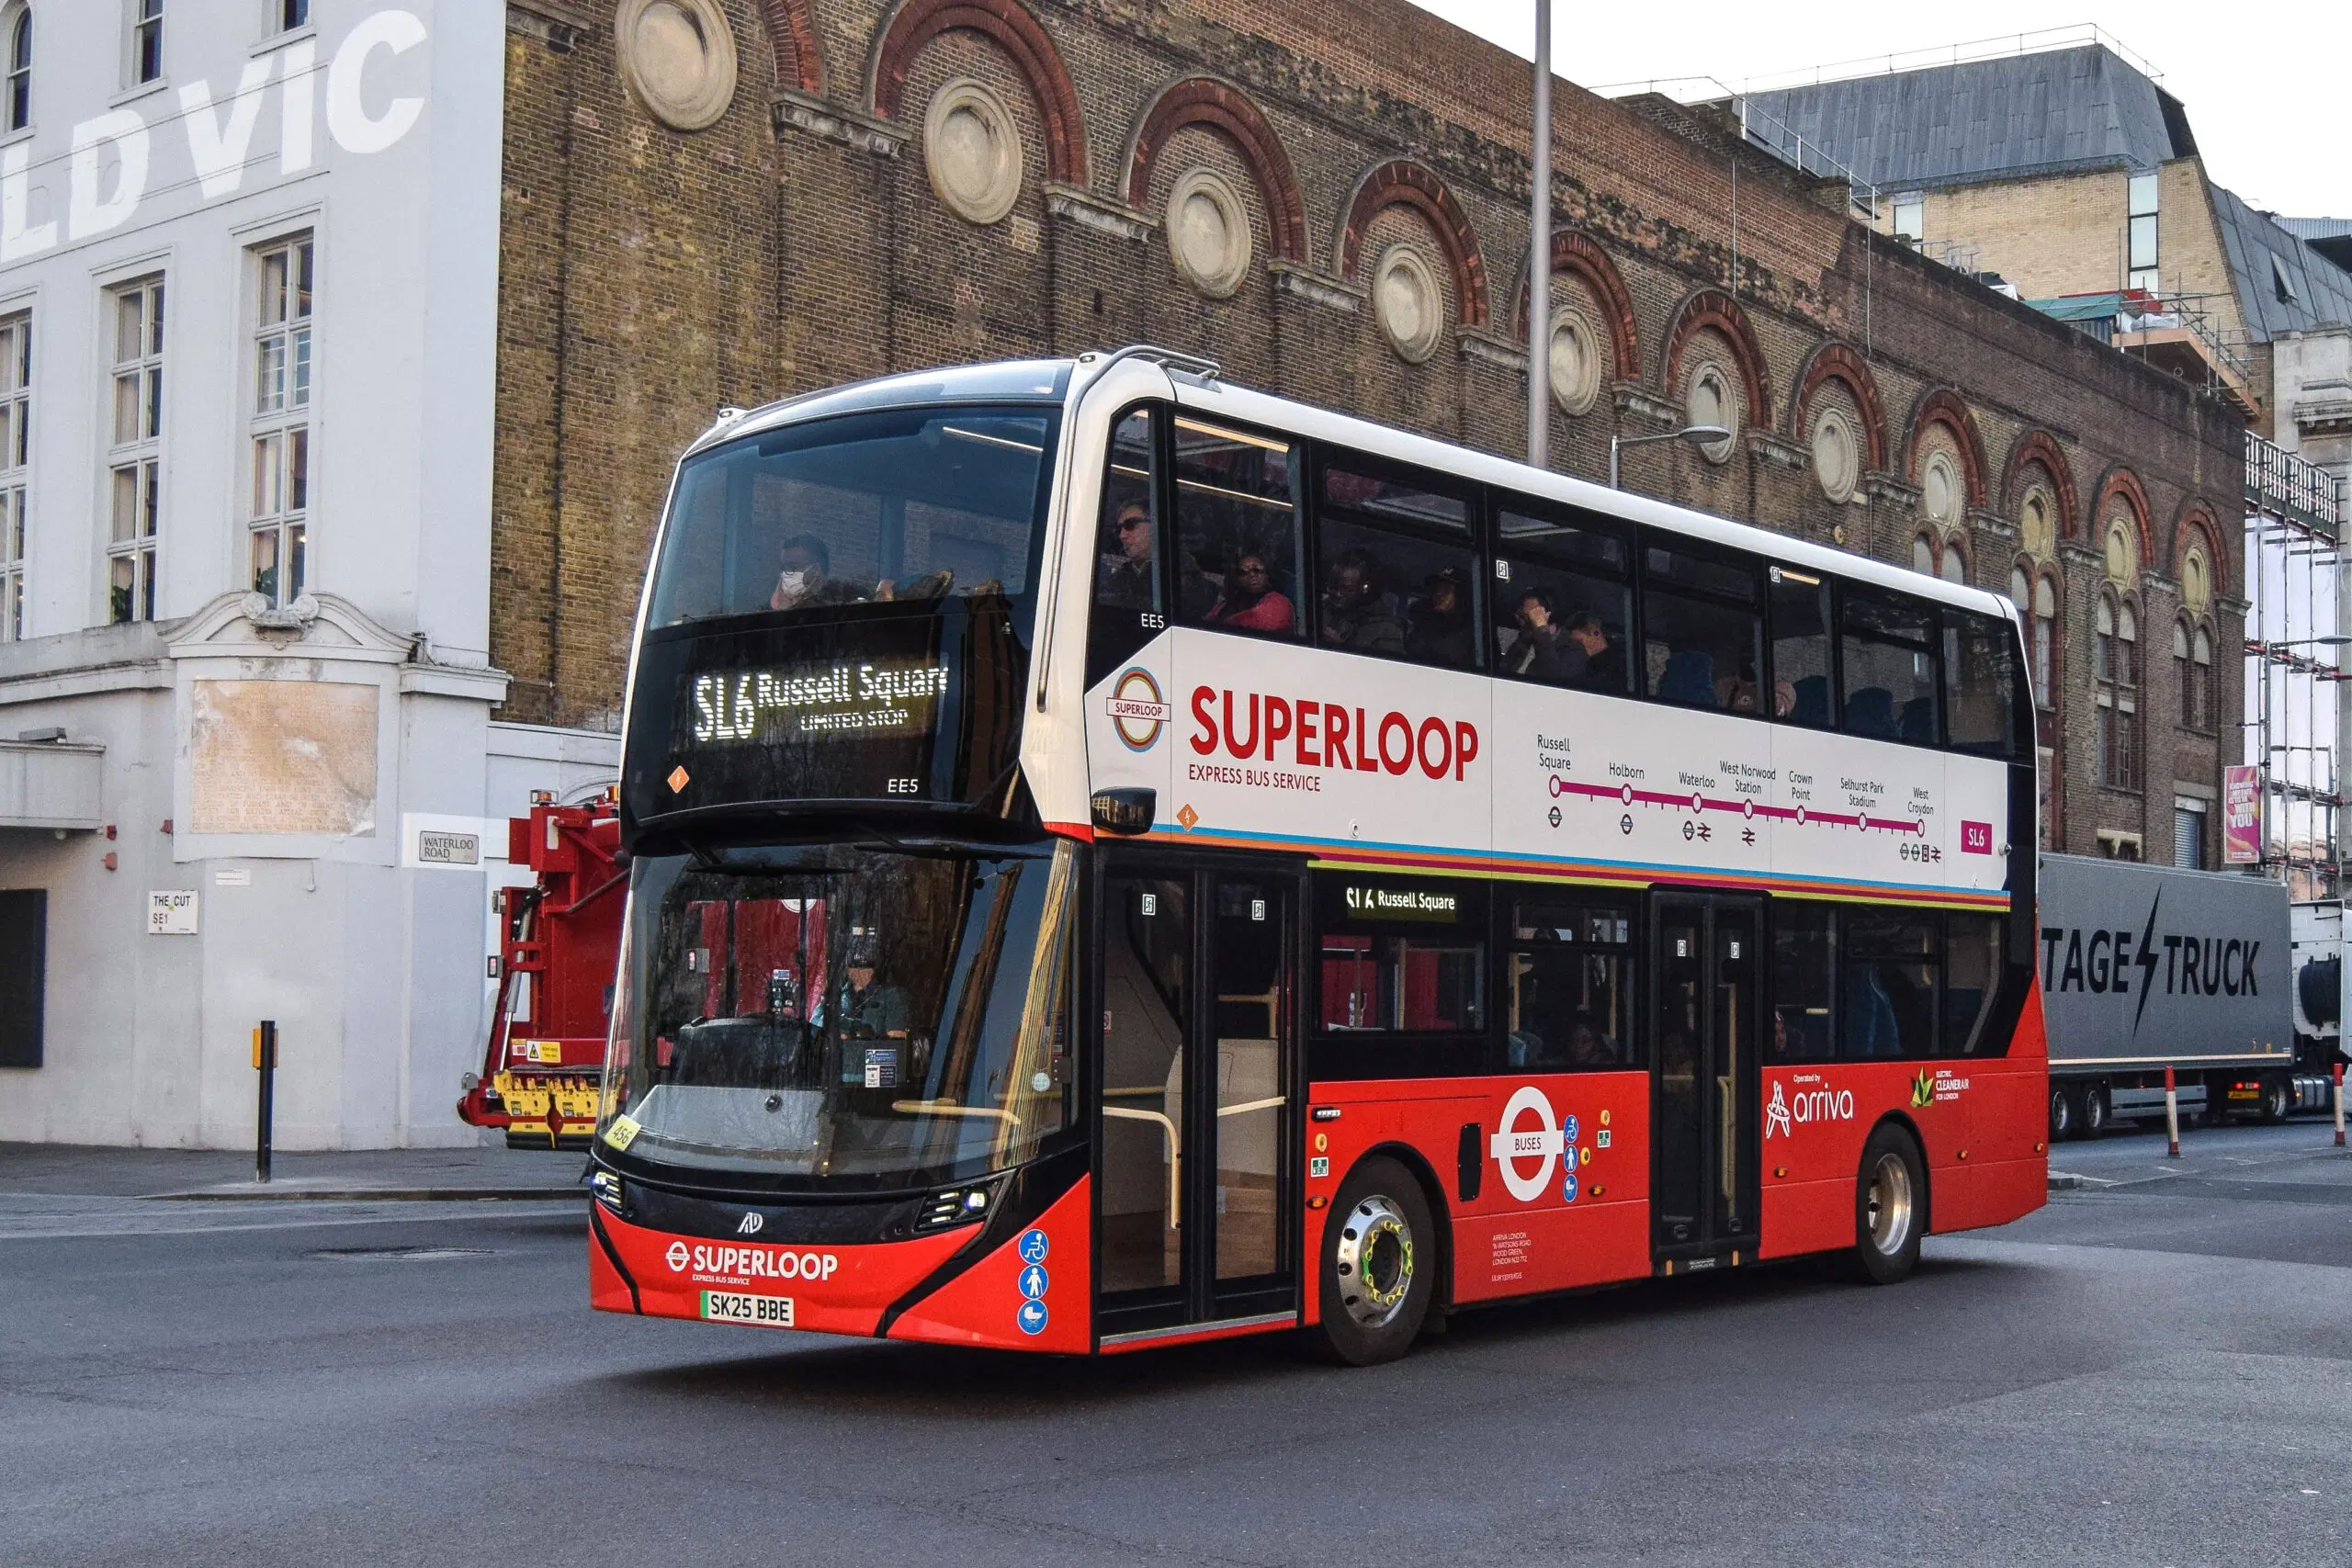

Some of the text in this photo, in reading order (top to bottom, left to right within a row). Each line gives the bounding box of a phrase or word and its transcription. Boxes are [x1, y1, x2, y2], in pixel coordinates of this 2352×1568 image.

[178, 10, 427, 199] VIC
[1141, 613, 1165, 629] EE5
[695, 675, 755, 742] SL6
[757, 667, 852, 708] Russell
[1115, 702, 1162, 717] SUPERLOOP
[800, 708, 909, 731] LIMITED STOP
[1189, 685, 1478, 782] SUPERLOOP
[1537, 734, 1571, 752] Russell
[1539, 752, 1571, 771] Square
[1189, 763, 1320, 793] EXPRESS BUS SERVICE
[1609, 761, 1645, 780] Holborn
[1720, 760, 1776, 781] West Norwood
[1789, 771, 1813, 785] Crown
[888, 778, 919, 794] EE5
[1679, 772, 1715, 788] Waterloo
[1735, 779, 1762, 795] Station
[1840, 777, 1884, 795] Selhurst Park
[1792, 788, 1811, 801] Point
[1849, 794, 1876, 808] Stadium
[1913, 786, 1928, 800] West
[1907, 801, 1934, 817] Croydon
[2230, 813, 2253, 829] YOU
[424, 837, 474, 851] WATERLOO
[1968, 828, 1985, 847] SL6
[424, 847, 450, 858] ROAD
[153, 896, 191, 907] THE CUT
[1377, 889, 1418, 908] Russell
[1419, 892, 1455, 912] Square
[153, 913, 168, 924] SE1
[2164, 935, 2260, 997] TRUCK
[1793, 1074, 1821, 1084] Operated by
[1793, 1082, 1853, 1122] arriva
[613, 1125, 633, 1145] 456
[1514, 1137, 1542, 1151] BUSES
[1508, 1232, 1527, 1240] LONDON
[1493, 1249, 1508, 1258] WOOD
[693, 1245, 838, 1281] SUPERLOOP
[1492, 1258, 1511, 1266] LONDON
[692, 1273, 715, 1282] EXPRESS
[727, 1276, 751, 1285] SERVICE
[710, 1294, 790, 1322] SK25 BBE
